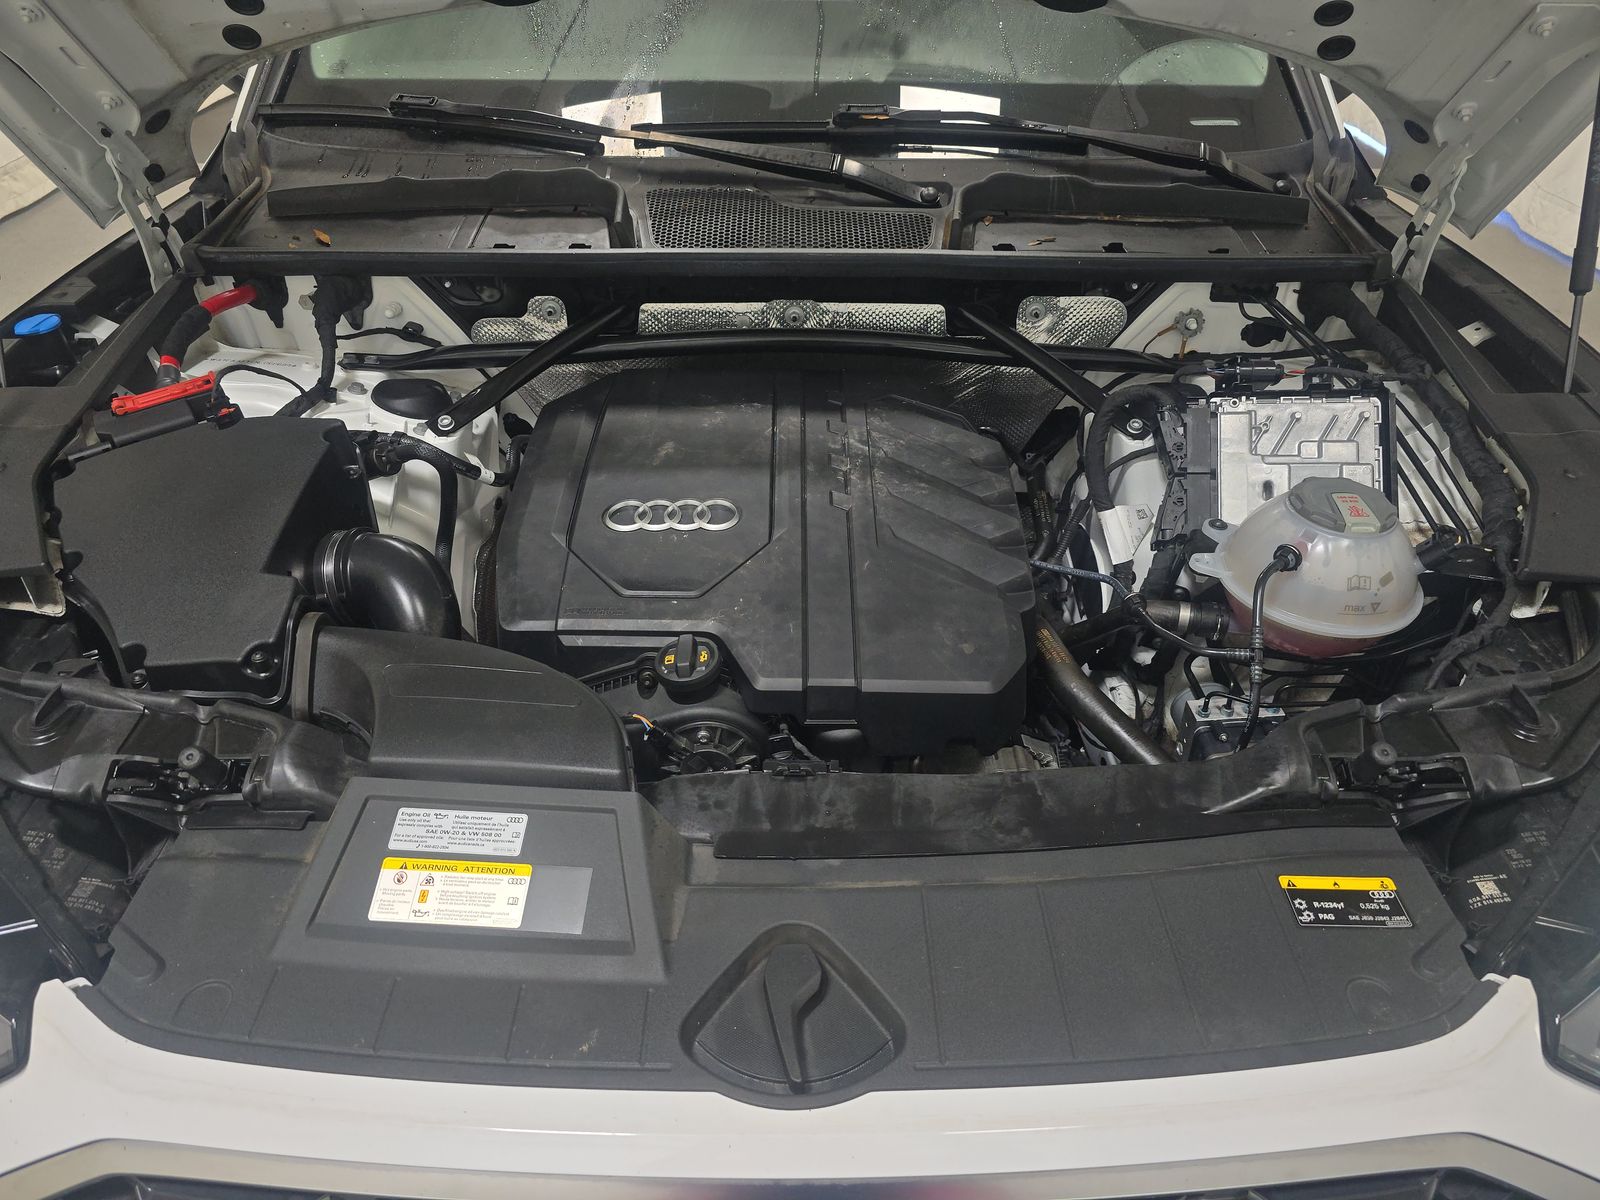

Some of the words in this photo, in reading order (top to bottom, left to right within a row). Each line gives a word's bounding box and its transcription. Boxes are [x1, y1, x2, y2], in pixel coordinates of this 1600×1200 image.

[1344, 604, 1365, 613] max
[412, 863, 458, 872] WARNING
[463, 866, 516, 875] ATTENTION
[1312, 901, 1344, 910] R-1234yf
